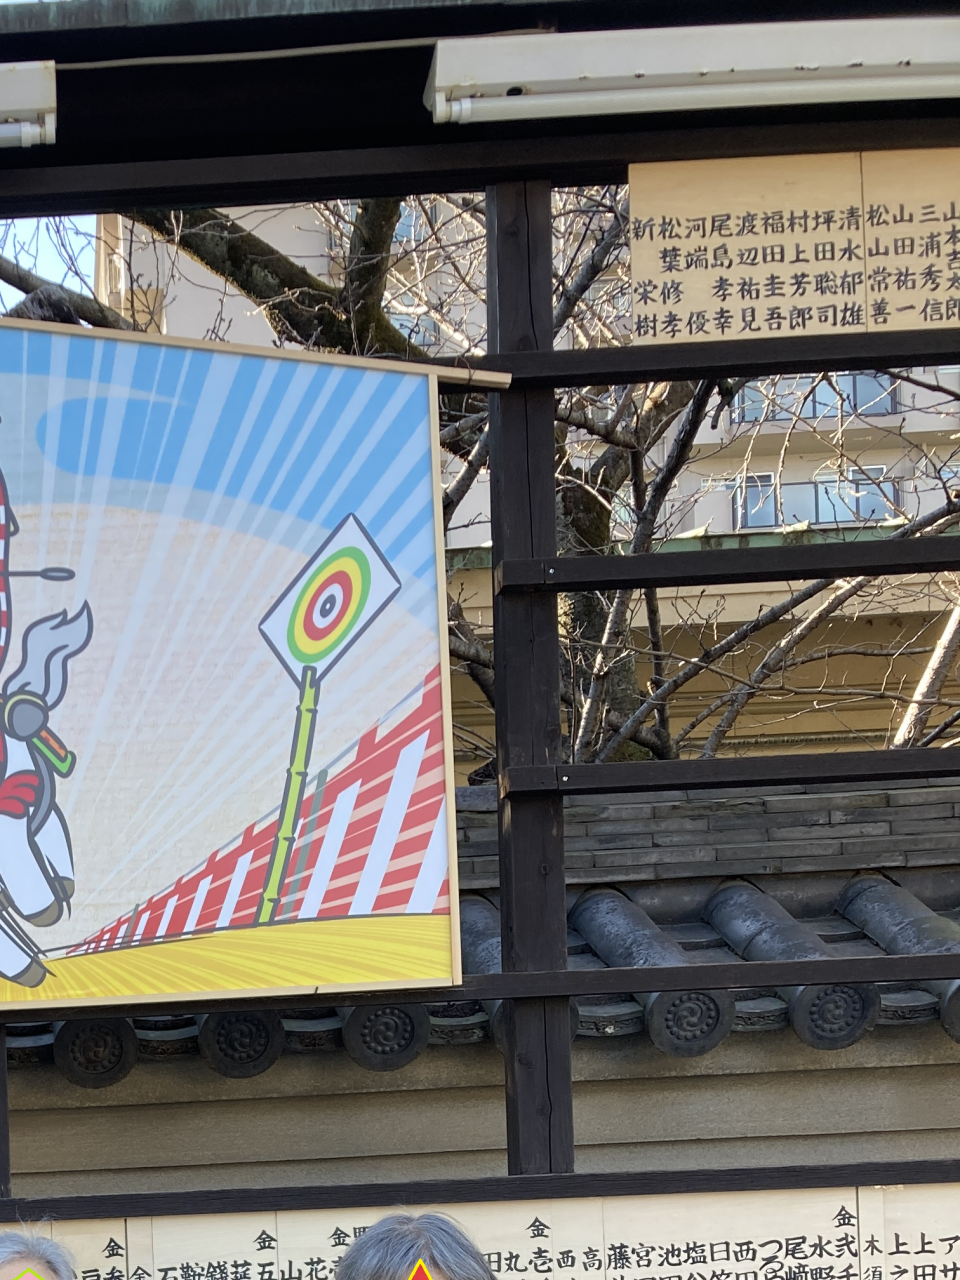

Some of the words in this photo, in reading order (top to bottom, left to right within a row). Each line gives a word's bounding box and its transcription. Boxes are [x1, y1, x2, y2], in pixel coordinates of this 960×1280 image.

[709, 213, 734, 335] 尾島孝幸
[761, 210, 787, 331] 福田圭吾
[786, 209, 813, 331] 村上芳郎
[838, 205, 865, 326] 清水郁雄
[866, 204, 892, 324] 松山常善
[892, 203, 916, 312] 山田祐一
[918, 204, 944, 321] 三浦秀信
